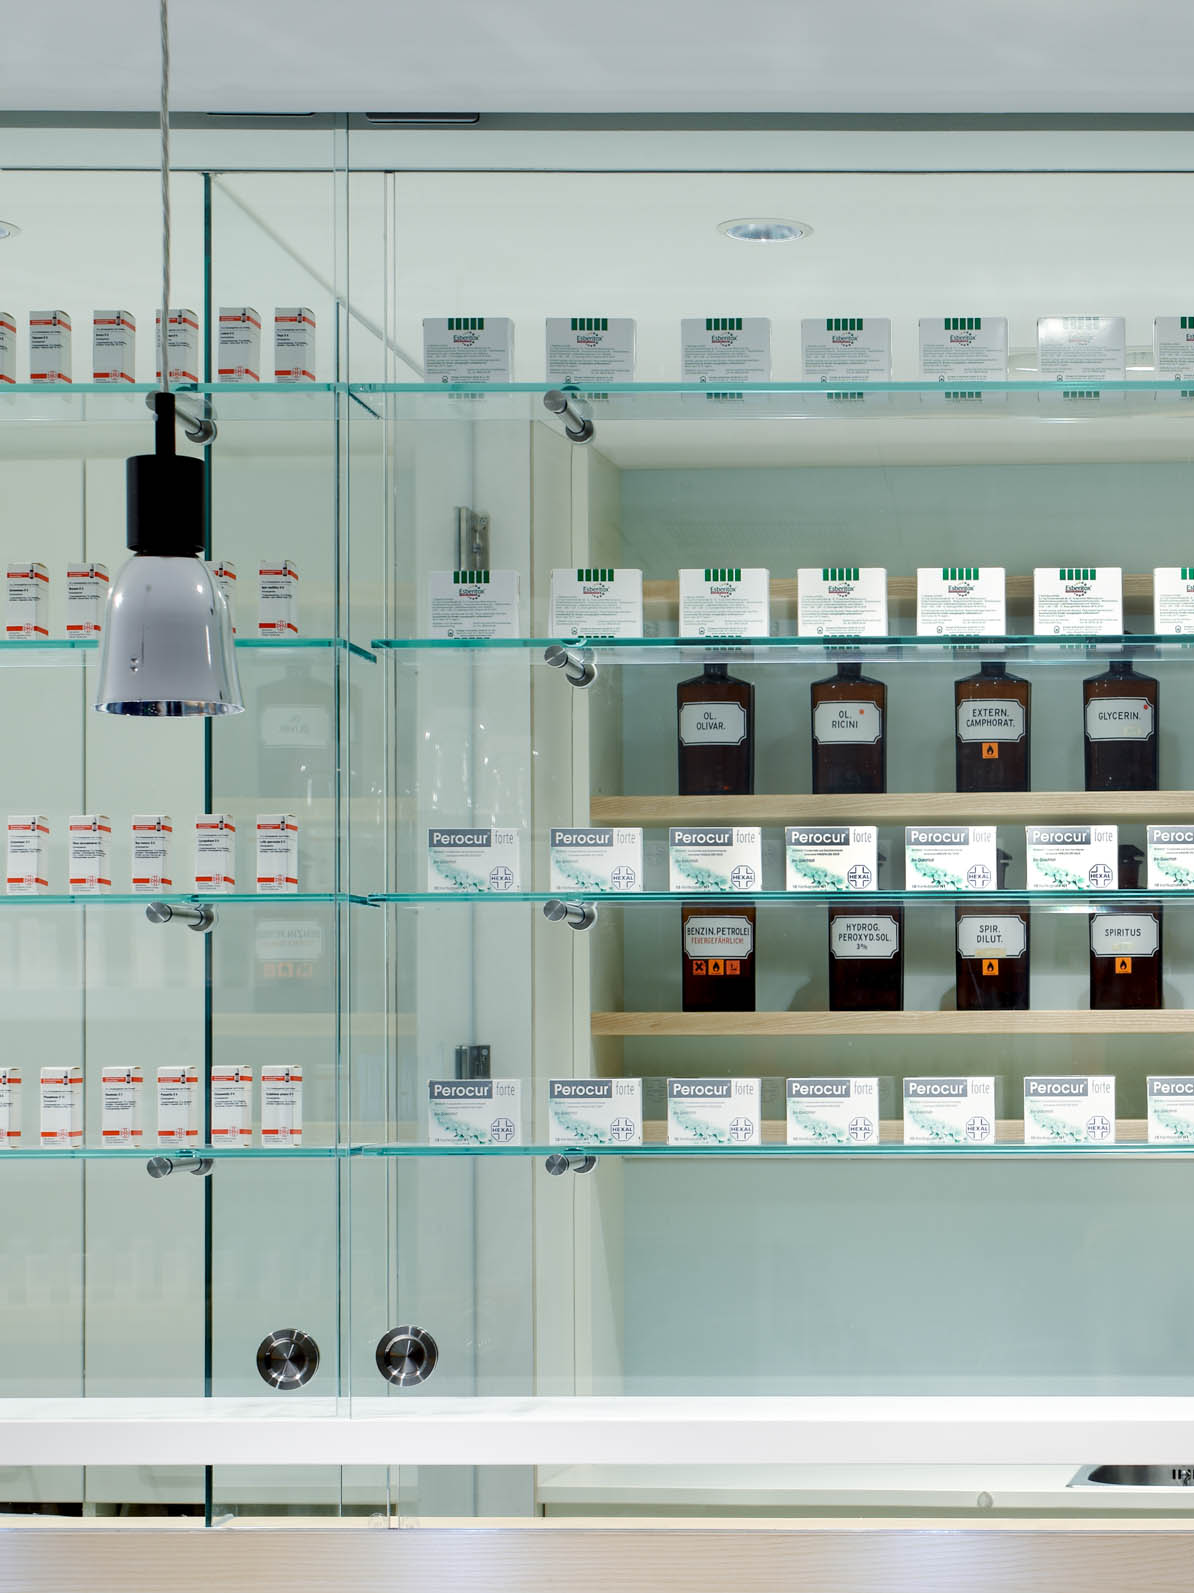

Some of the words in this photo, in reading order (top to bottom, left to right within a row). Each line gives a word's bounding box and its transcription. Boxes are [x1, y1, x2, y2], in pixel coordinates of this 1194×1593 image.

[972, 709, 1009, 717] EXTERN.
[1098, 711, 1141, 721] GLYCERIN.
[831, 721, 858, 729] RICINI
[966, 719, 1016, 728] CAMPHORAT.
[433, 832, 488, 844] Perocur
[495, 832, 513, 844] forte
[555, 832, 610, 844] Perocur
[617, 831, 636, 844] forte
[675, 832, 729, 843] Perocur
[737, 830, 756, 843] forte
[792, 832, 846, 843] Perocur
[853, 830, 872, 843] forte
[911, 831, 965, 843] Perocur
[973, 829, 991, 842] forte
[1033, 830, 1087, 842] Perocur
[1094, 829, 1113, 842] forte
[846, 923, 881, 931] HYDROG.
[979, 925, 1001, 933] SPIR.
[1104, 928, 1142, 937] SPIRITUS
[976, 935, 1003, 943] DILUT.
[434, 1085, 489, 1096] Perocur
[496, 1083, 515, 1096] forte
[554, 1084, 609, 1095] Perocur
[616, 1082, 634, 1095] forte
[673, 1084, 728, 1095] Perocur
[735, 1082, 754, 1095] forte
[792, 1083, 847, 1095] Perocur
[854, 1082, 872, 1094] forte
[910, 1083, 964, 1094] Perocur
[971, 1081, 990, 1094] forte
[1030, 1082, 1084, 1094] Perocur
[1092, 1080, 1110, 1093] forte
